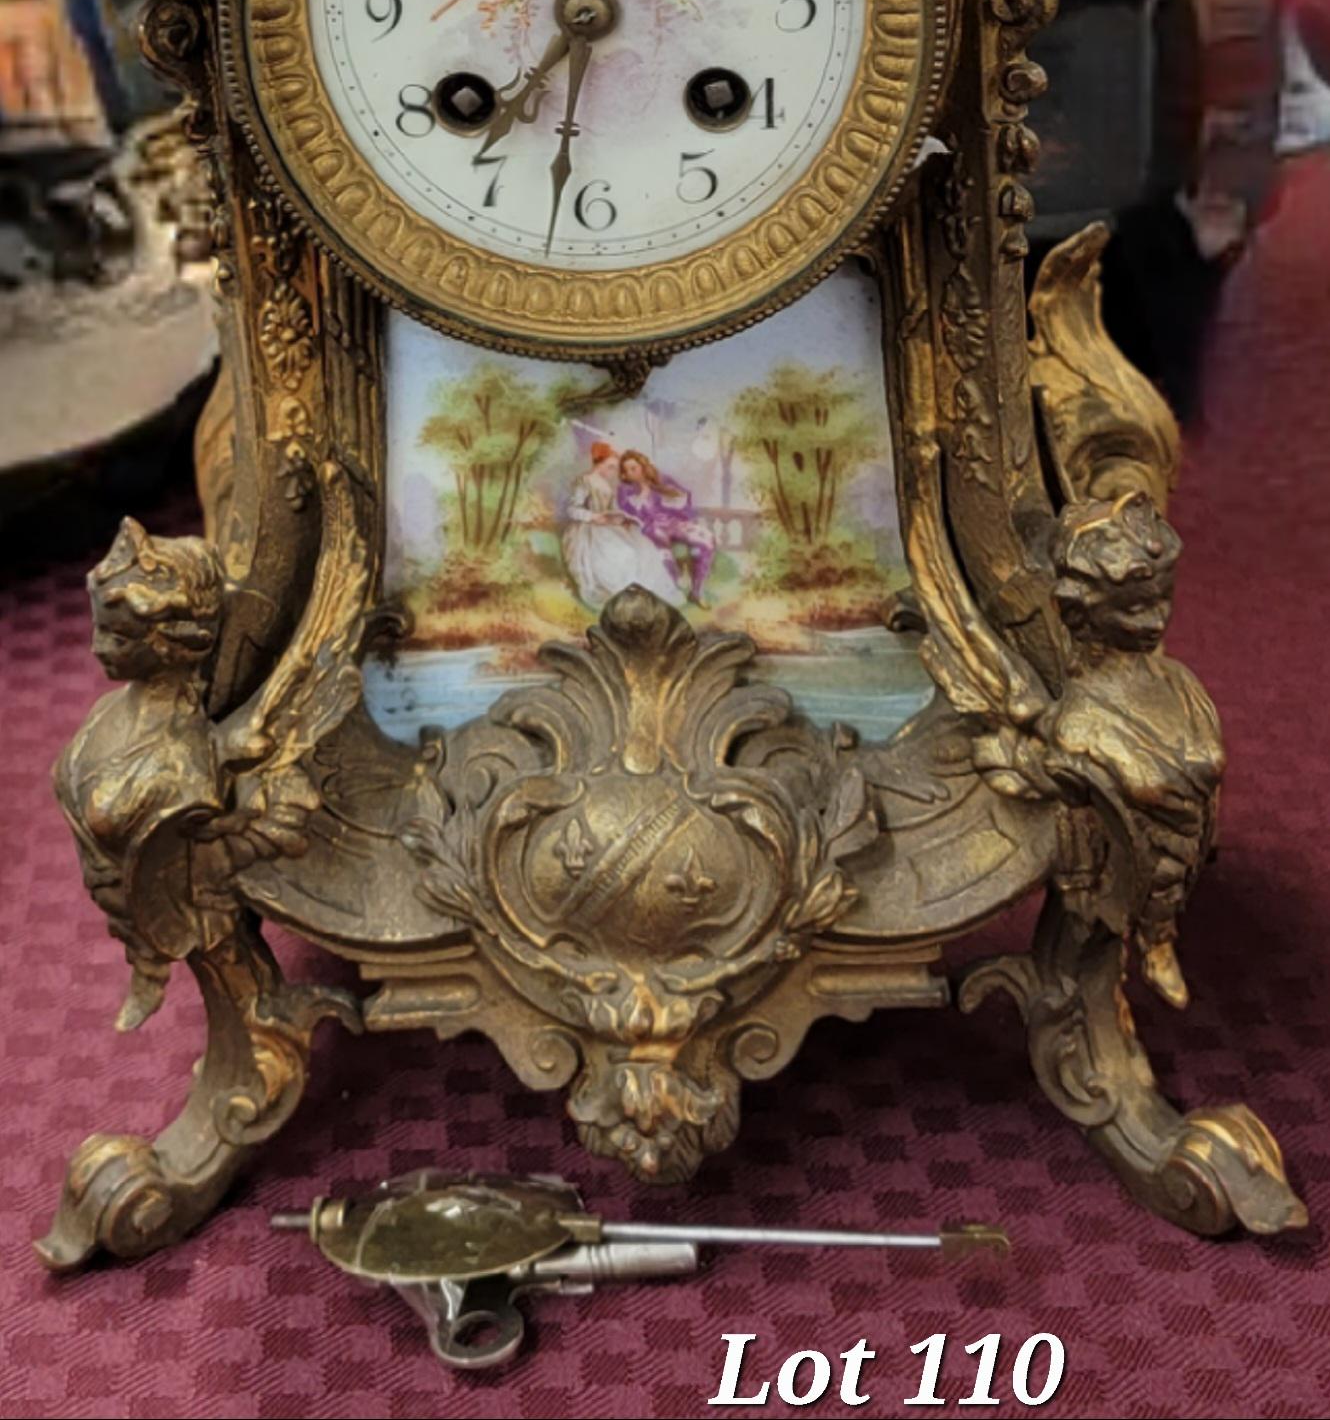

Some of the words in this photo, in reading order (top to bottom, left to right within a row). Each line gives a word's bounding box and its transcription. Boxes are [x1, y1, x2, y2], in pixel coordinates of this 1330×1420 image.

[396, 84, 436, 138] 8
[747, 77, 785, 130] 4
[471, 155, 508, 208] 7
[676, 149, 718, 204] 5
[574, 180, 617, 231] 6
